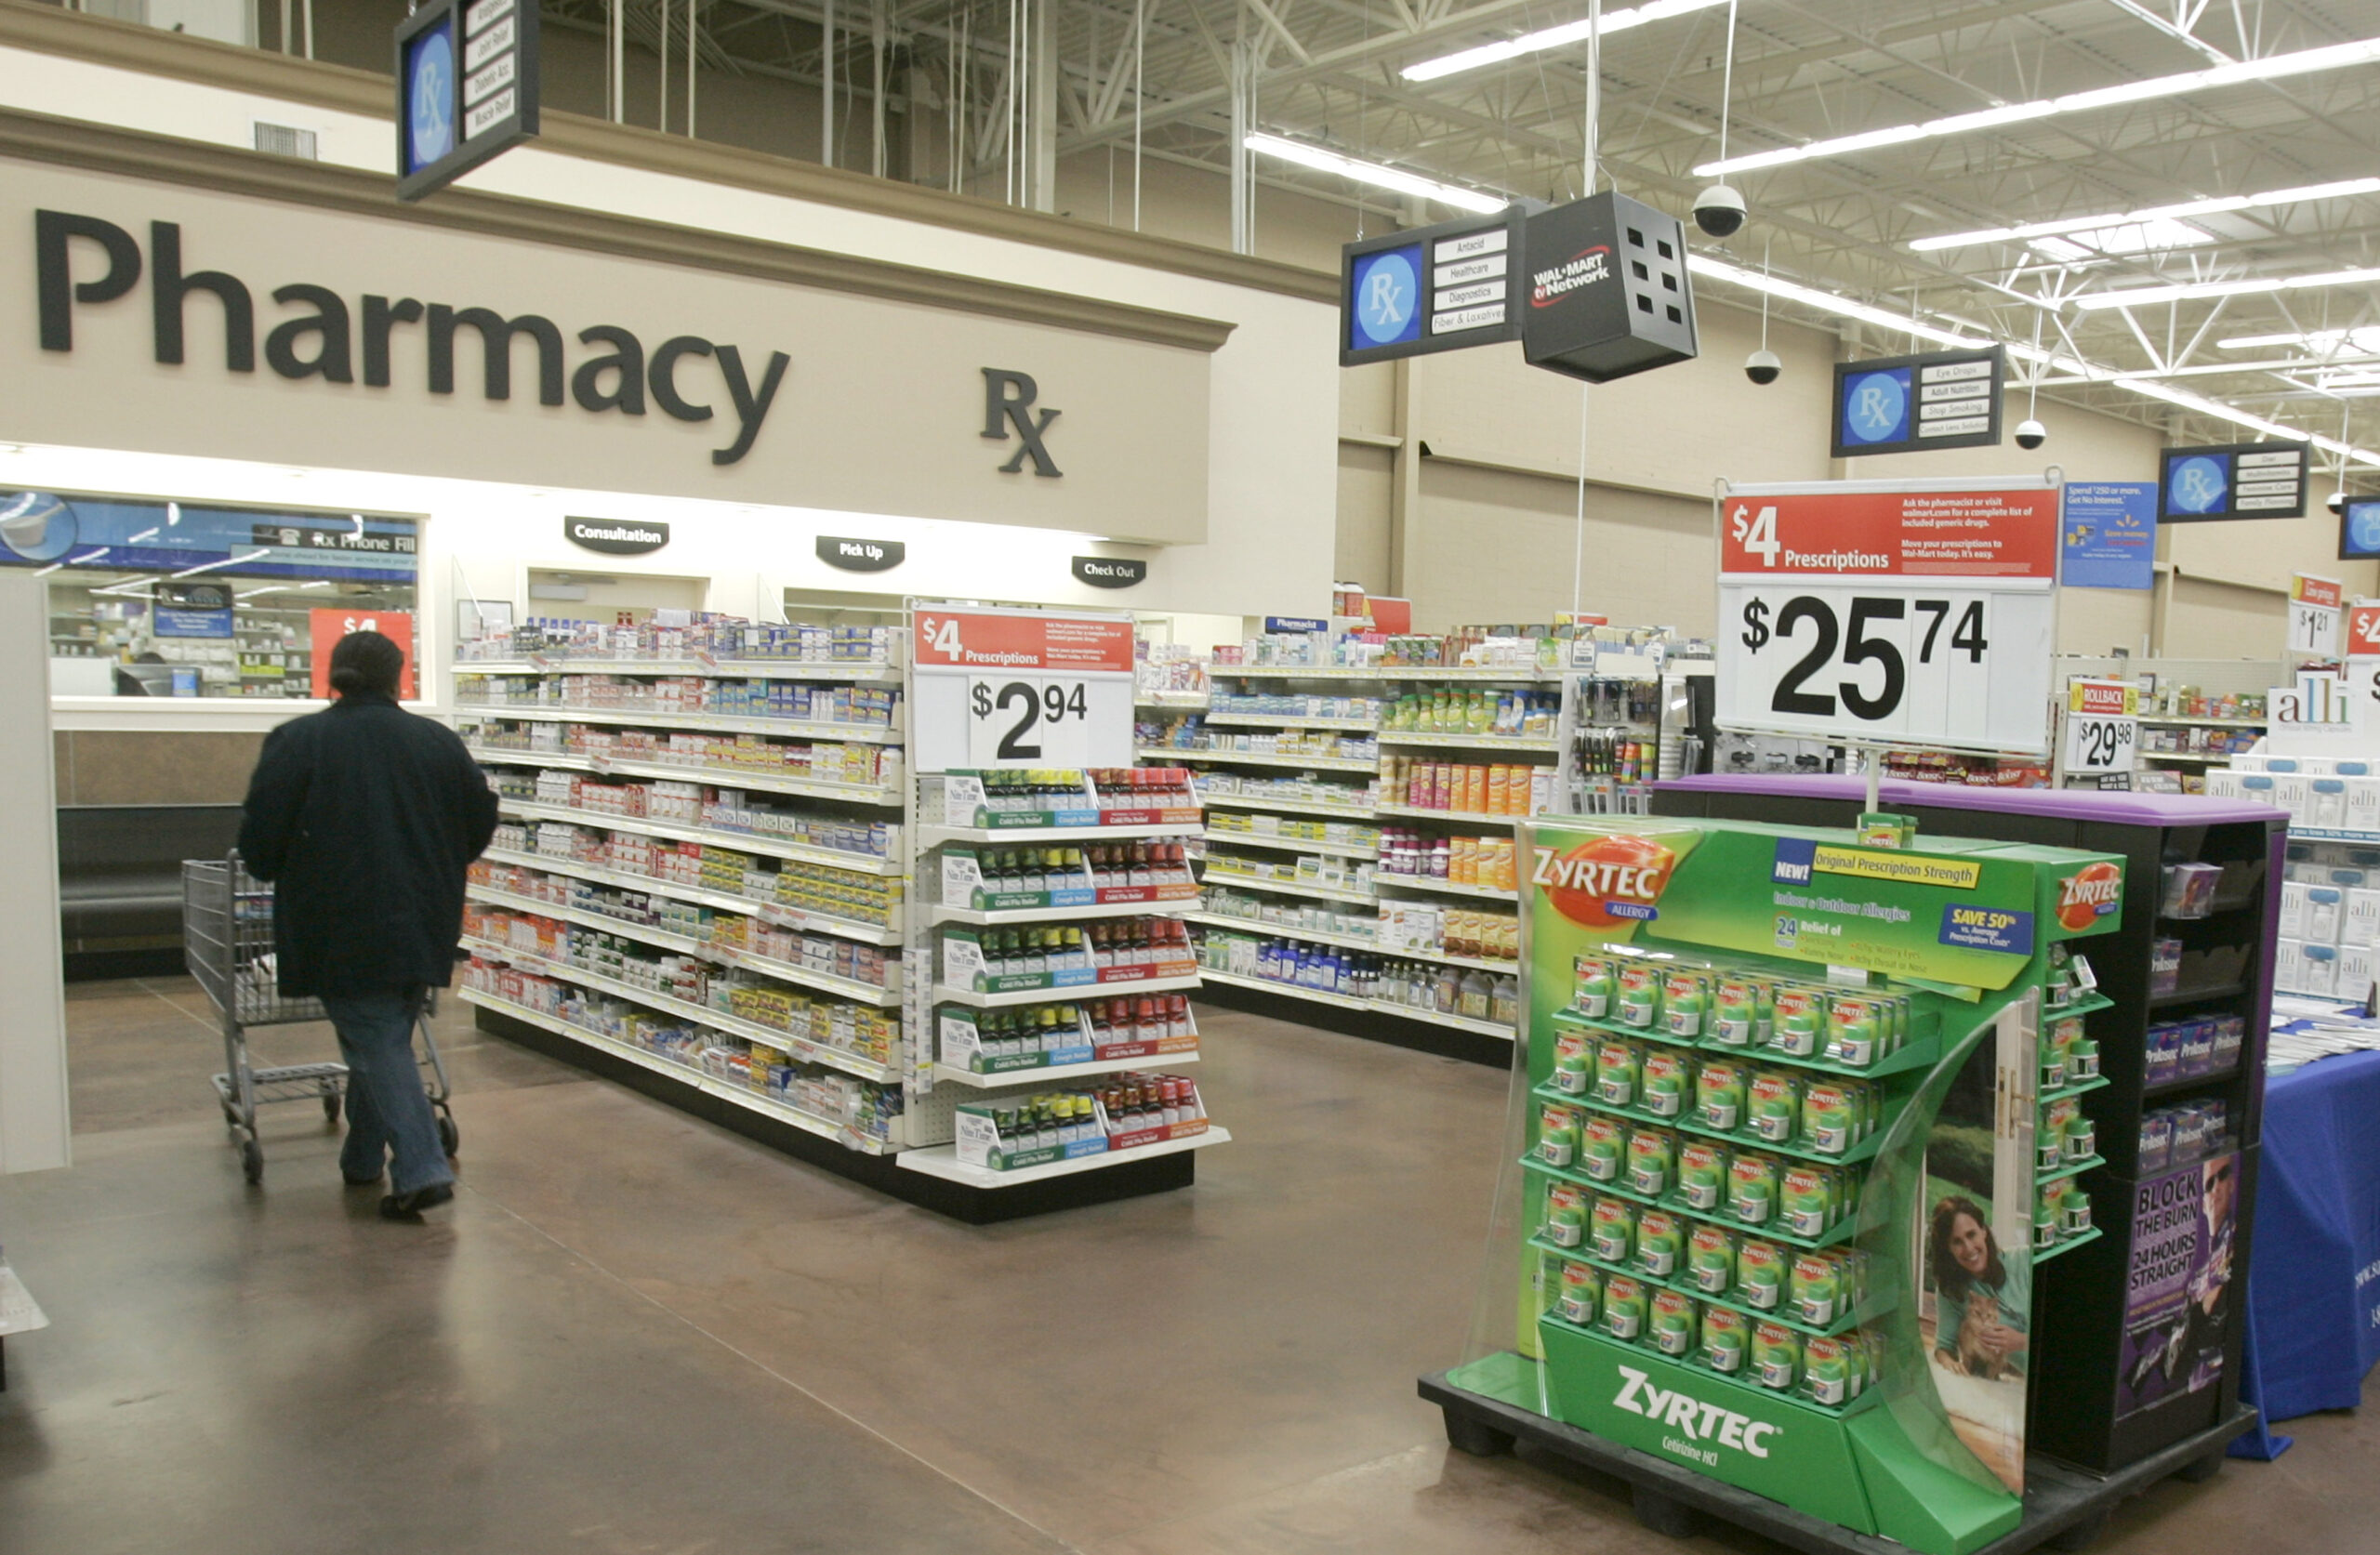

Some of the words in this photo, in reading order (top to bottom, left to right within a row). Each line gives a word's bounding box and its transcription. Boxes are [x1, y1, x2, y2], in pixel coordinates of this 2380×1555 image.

[1457, 238, 1485, 253] Antacid
[1450, 263, 1489, 279] Healthcare
[1546, 267, 1609, 296] Network
[1449, 287, 1491, 303] Diagnostics
[1435, 317, 1454, 328] Fiber
[1457, 312, 1463, 324] &
[34, 206, 790, 467] Pharmacy
[1937, 368, 1950, 377] Eye
[1953, 366, 1977, 376] Drops
[1931, 388, 1949, 396] Adult
[1950, 384, 1979, 395] Nutrition
[1929, 406, 1946, 415] Stop
[1950, 403, 1982, 415] Smoking
[980, 367, 1063, 477] Rx
[1919, 424, 1943, 433] Contact
[2069, 487, 2092, 495] Spend
[1931, 498, 1974, 507] pharmacist
[1902, 508, 1950, 517] walmart.com
[1951, 508, 1964, 517] for
[1971, 508, 2007, 518] complete
[2009, 507, 2022, 516] list
[2023, 507, 2032, 516] of
[1902, 519, 1934, 527] included
[1936, 519, 1964, 529] generic
[1964, 519, 1990, 529] drugs.
[575, 524, 662, 544] Consultation
[1732, 504, 1780, 567] $4
[340, 534, 390, 550] Phone
[394, 537, 415, 552] Fill
[840, 543, 863, 557] Pick
[866, 544, 883, 560] Up
[1924, 540, 1940, 549] your
[1941, 539, 1992, 549] prescriptions
[1784, 549, 1889, 572] Prescriptions
[1937, 549, 1960, 559] today.
[1975, 551, 1994, 560] easy.
[1084, 563, 1115, 578] Check
[1117, 565, 1135, 579] Out
[922, 616, 963, 662] $4
[966, 650, 1038, 665] Prescriptions
[2084, 689, 2122, 705] ROLLBACK
[2278, 678, 2351, 724] alli
[1532, 847, 1659, 899] ZYRTEC
[1775, 861, 1810, 881] NEW!
[1816, 853, 1856, 869] Original
[1858, 858, 1921, 876] Prescription
[1924, 865, 1972, 883] Strength
[2061, 877, 2122, 906] ZYRTEC
[1611, 904, 1651, 919] ALLERGY
[1774, 890, 1808, 908] Indoor
[1817, 897, 1861, 916] Outdoor
[1862, 902, 1911, 922] Allergies
[1952, 908, 1987, 927] SAVE
[1777, 917, 1797, 936] 24
[1800, 920, 1830, 934] Relief
[1831, 925, 1841, 936] of
[1971, 926, 2000, 937] Average
[1950, 931, 1989, 944] Prescription
[2138, 1172, 2198, 1216] BLOCK
[2135, 1214, 2161, 1238] THE
[2163, 1201, 2198, 1231] BURN
[2133, 1247, 2149, 1271] 24
[2150, 1232, 2197, 1263] HOURS
[2131, 1252, 2194, 1291] STRAIGHT
[1613, 1364, 1775, 1458] ZYRTEC
[1662, 1436, 1701, 1461] Cetirizine
[1702, 1450, 1718, 1468] HCl
